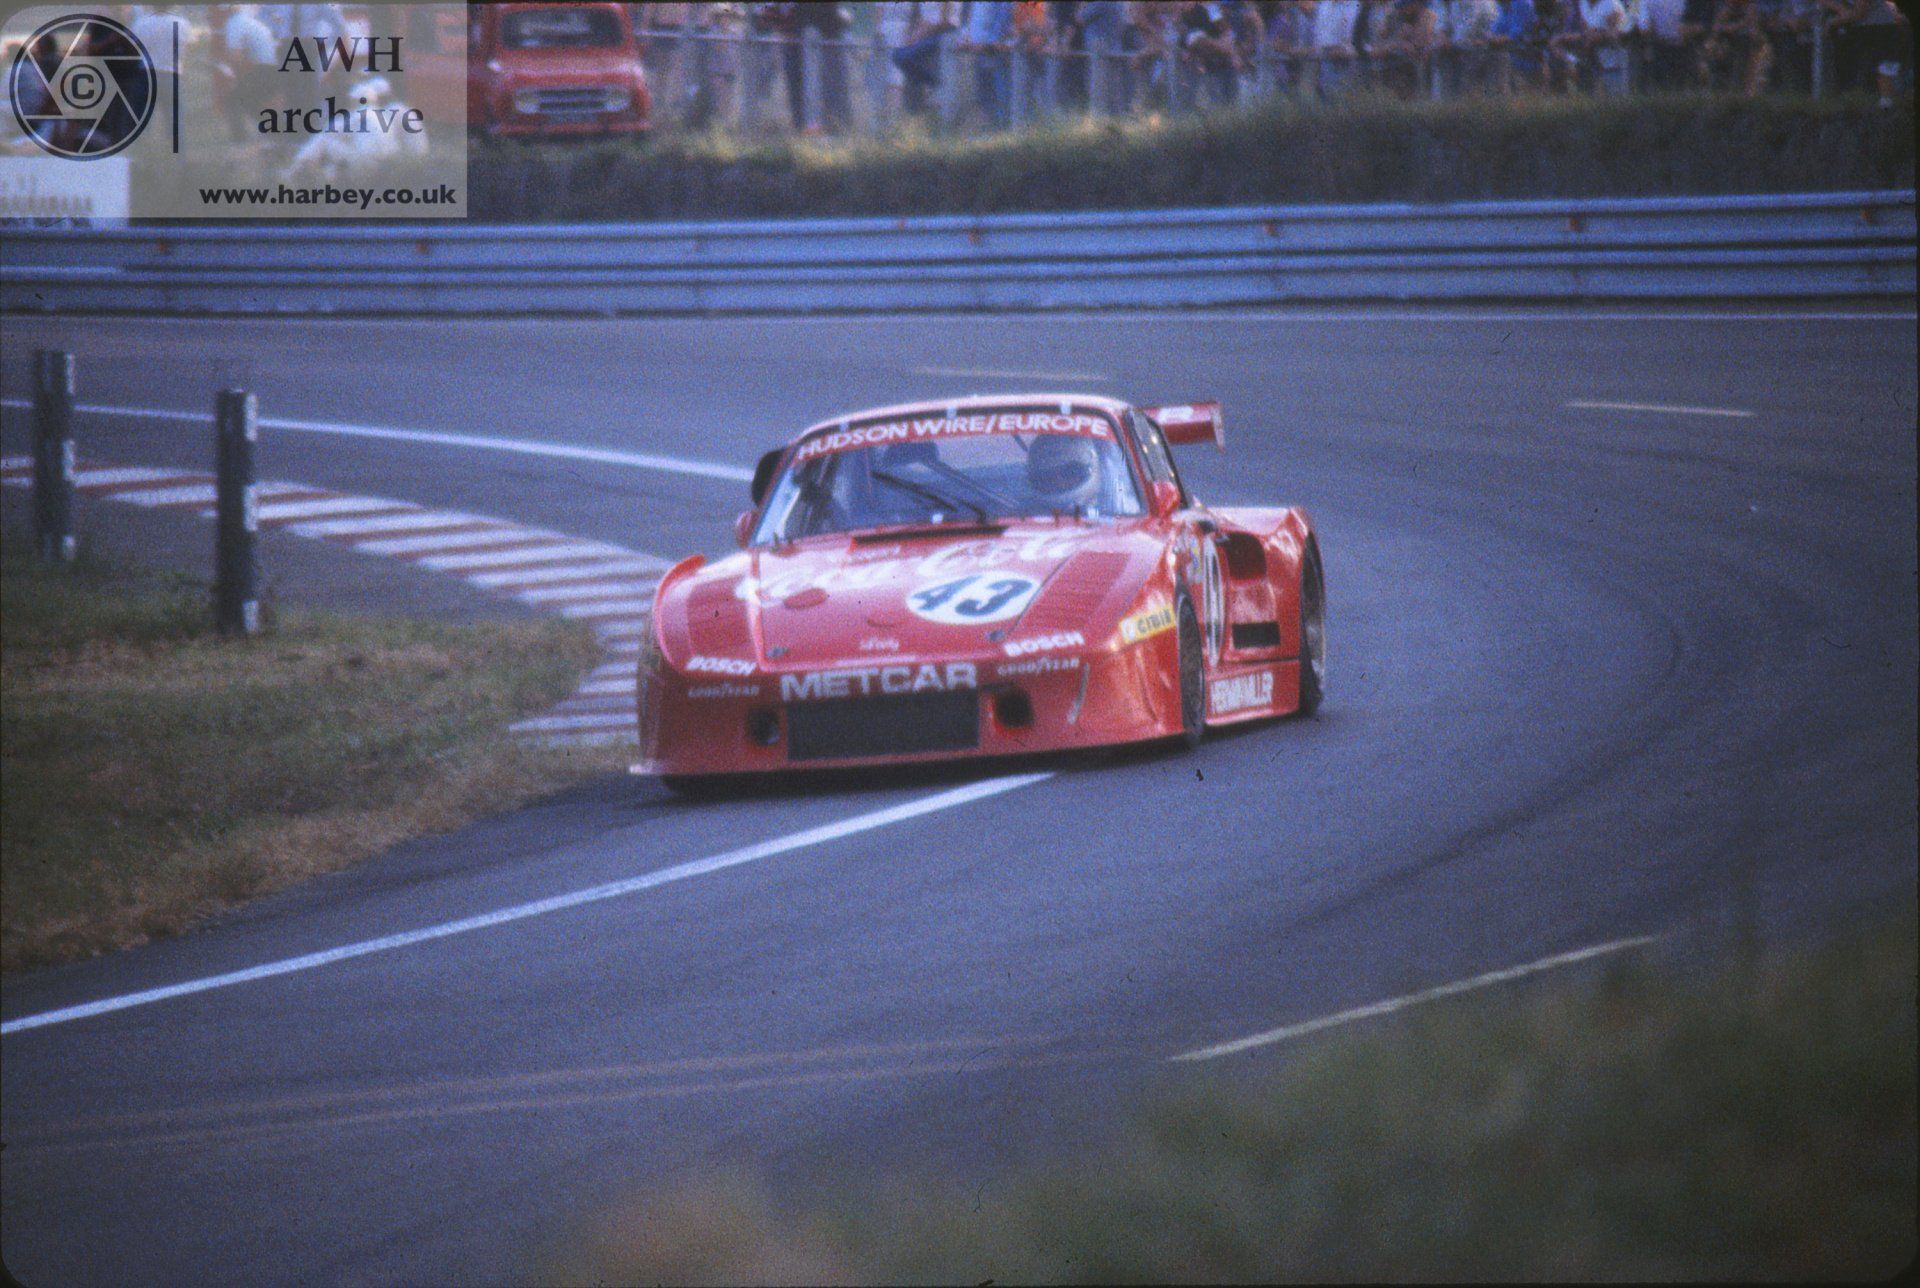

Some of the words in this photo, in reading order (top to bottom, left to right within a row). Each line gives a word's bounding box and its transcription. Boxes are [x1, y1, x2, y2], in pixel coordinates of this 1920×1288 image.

[798, 422, 909, 460] HUDSON
[912, 575, 1033, 617] 43
[1004, 630, 1085, 657] BOSCH
[685, 655, 757, 677] BOSCH
[780, 661, 977, 702] METCAR
